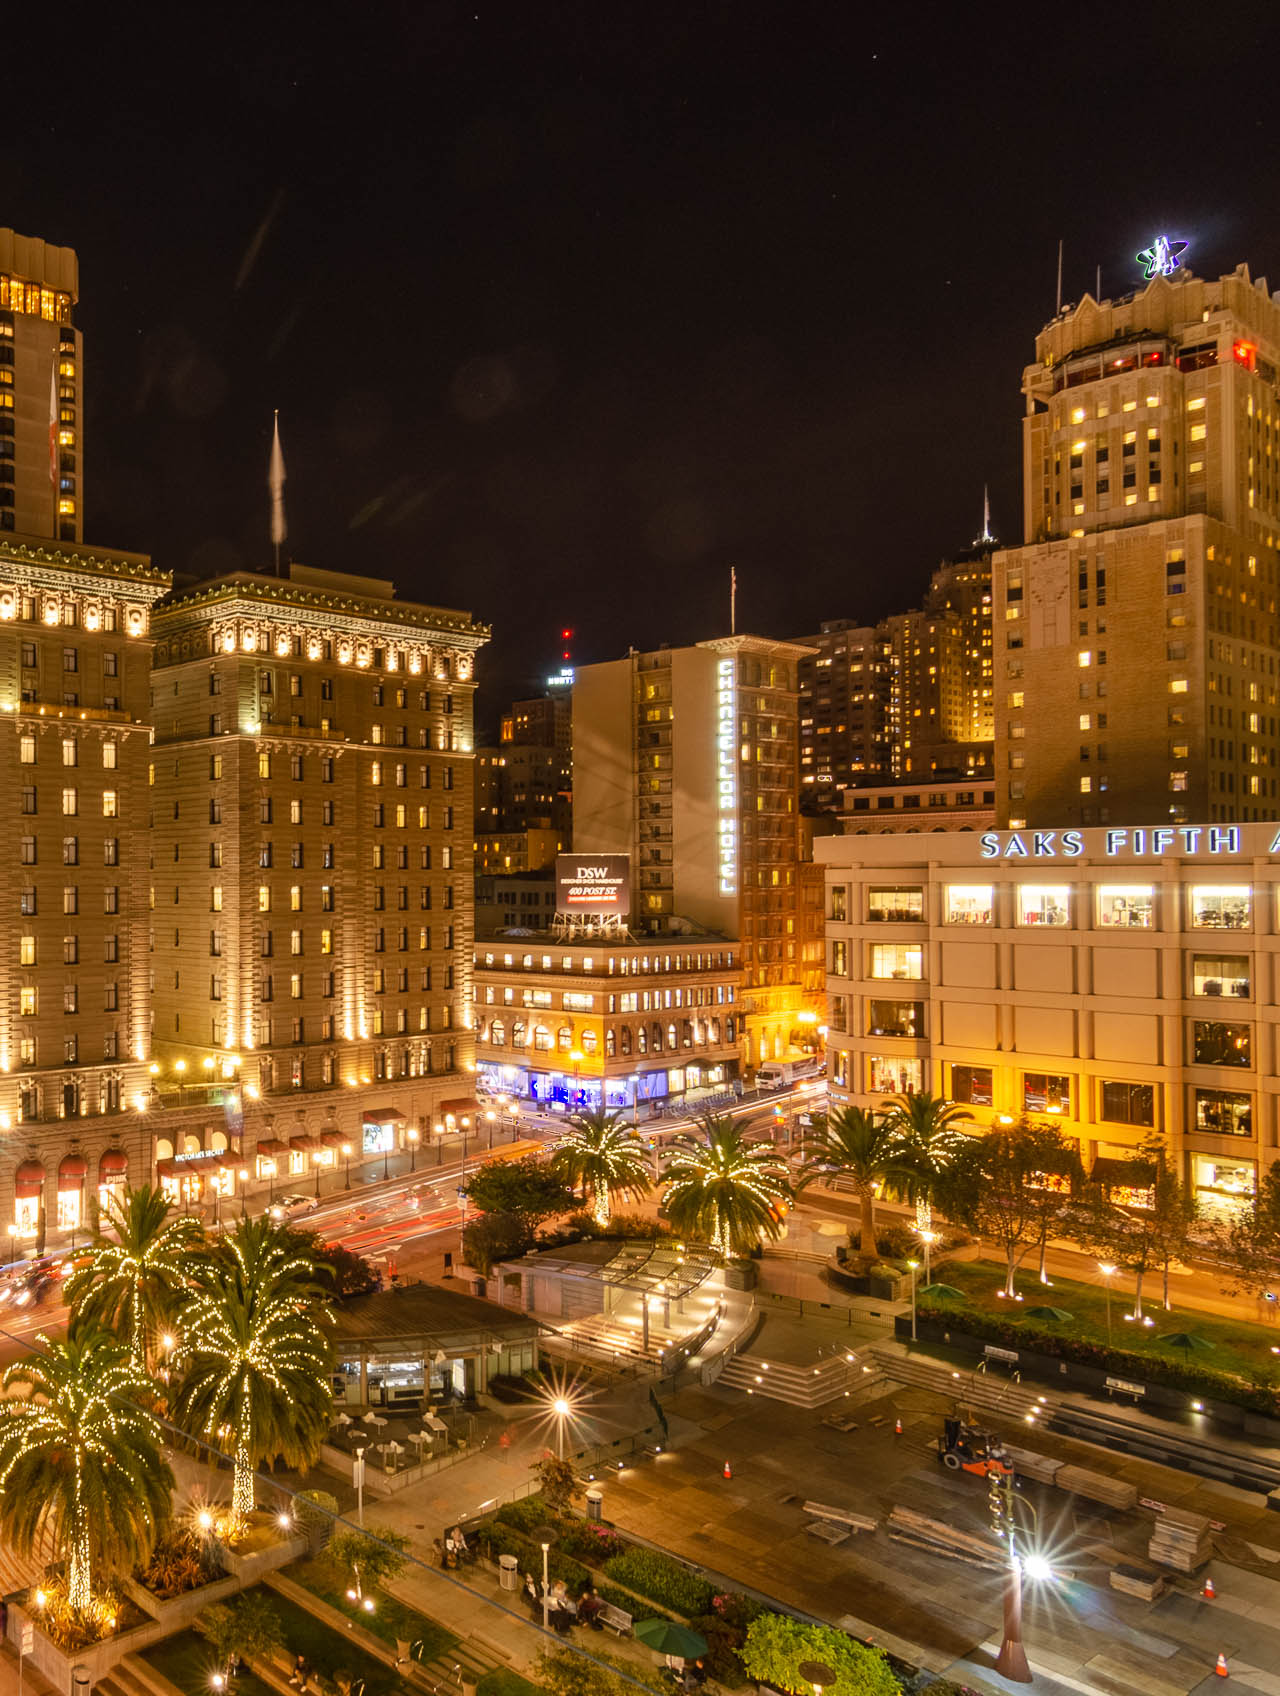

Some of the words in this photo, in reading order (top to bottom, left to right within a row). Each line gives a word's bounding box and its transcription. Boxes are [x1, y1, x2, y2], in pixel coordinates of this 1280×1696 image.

[718, 660, 735, 809] CHANCELLOR
[980, 831, 1084, 858] SAKS
[1106, 826, 1240, 856] FIFTH
[719, 818, 735, 892] HOTEL
[577, 867, 608, 879] DSW
[568, 887, 583, 895] 400
[582, 887, 605, 895] POST
[106, 1174, 127, 1184] PINK
